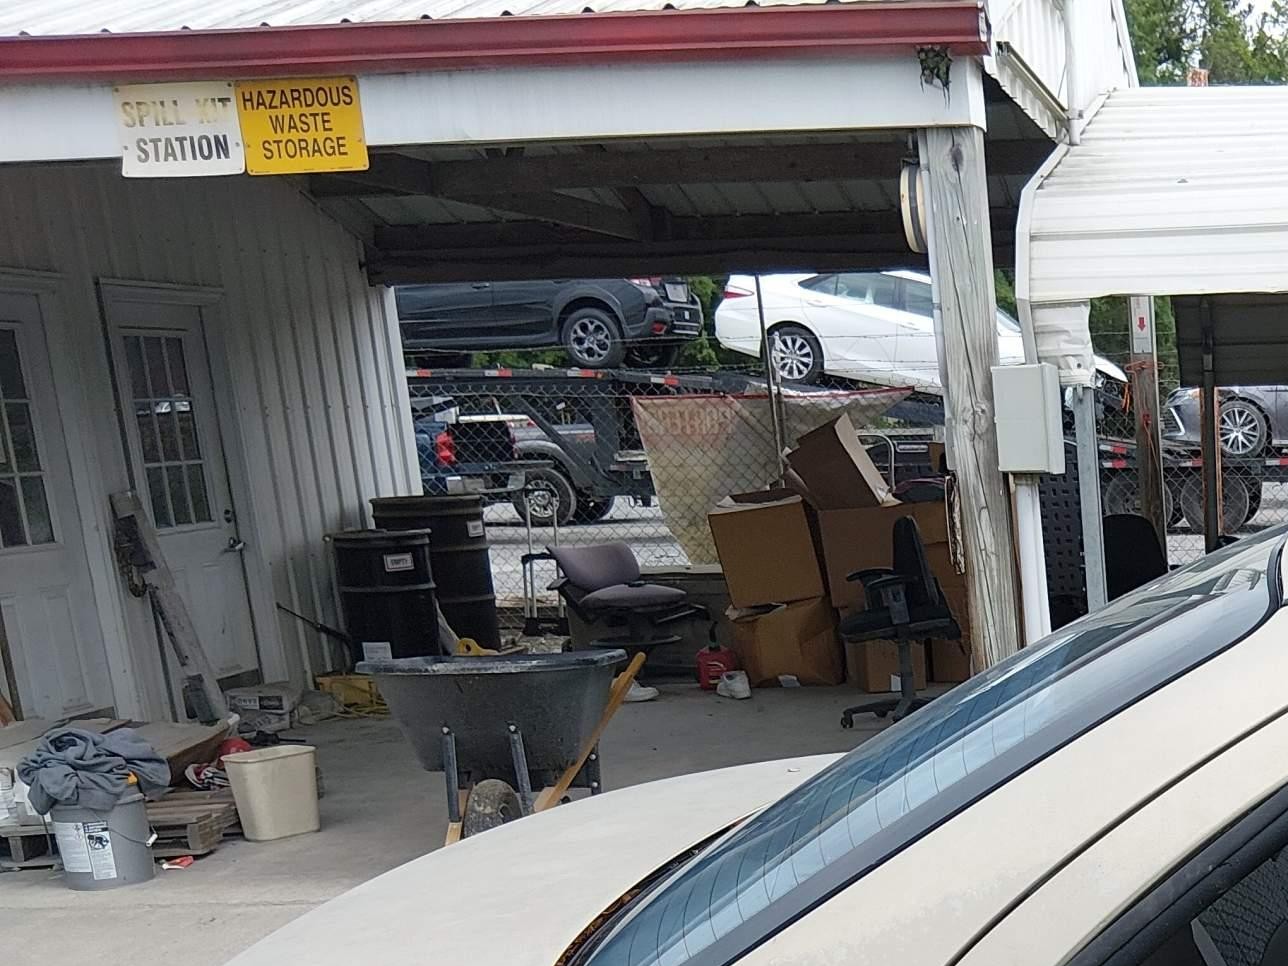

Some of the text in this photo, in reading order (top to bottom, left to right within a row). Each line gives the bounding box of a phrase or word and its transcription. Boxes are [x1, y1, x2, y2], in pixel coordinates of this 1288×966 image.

[242, 85, 353, 112] HAZARDOUS
[121, 99, 187, 128] SPILL
[269, 112, 333, 134] WASTE
[136, 134, 231, 163] STATION
[262, 136, 348, 160] STORAGE
